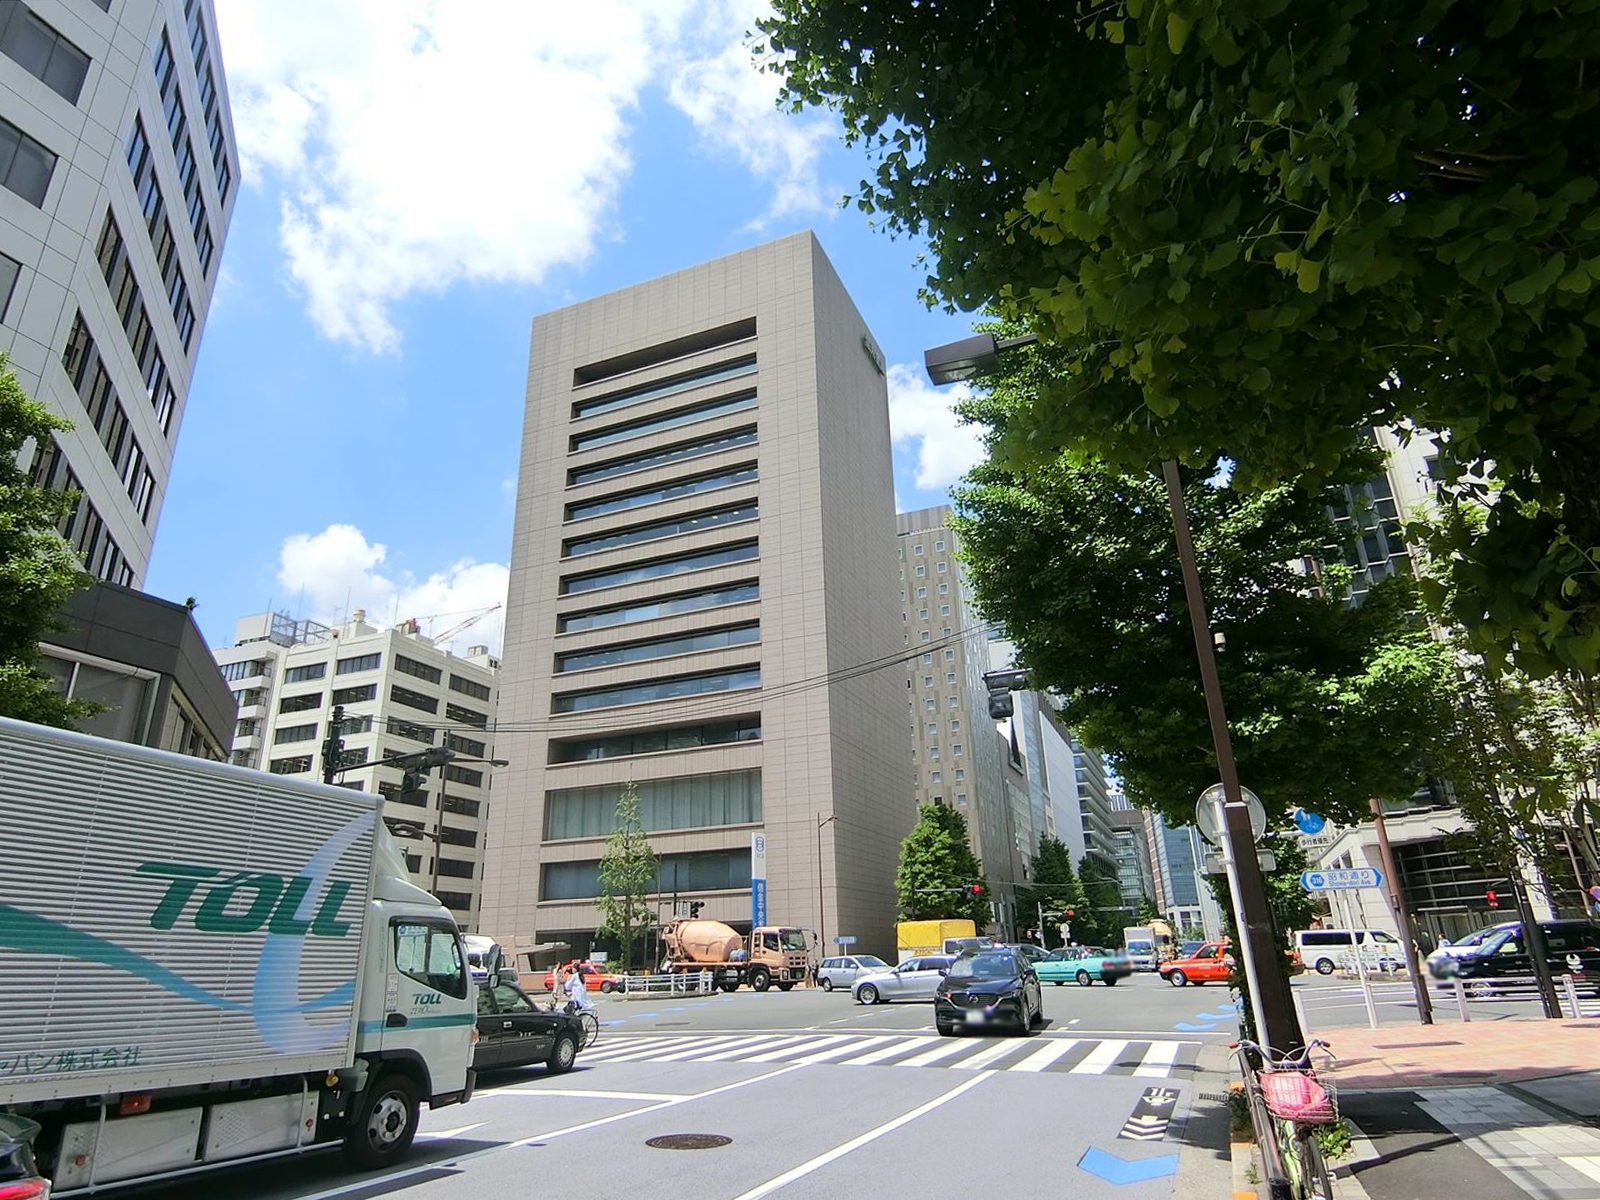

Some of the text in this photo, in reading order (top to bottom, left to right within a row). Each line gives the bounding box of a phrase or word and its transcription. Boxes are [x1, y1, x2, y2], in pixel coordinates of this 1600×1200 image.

[1327, 870, 1369, 881] 昭和通り
[131, 861, 352, 937] TOLL
[412, 993, 442, 1005] TOLL
